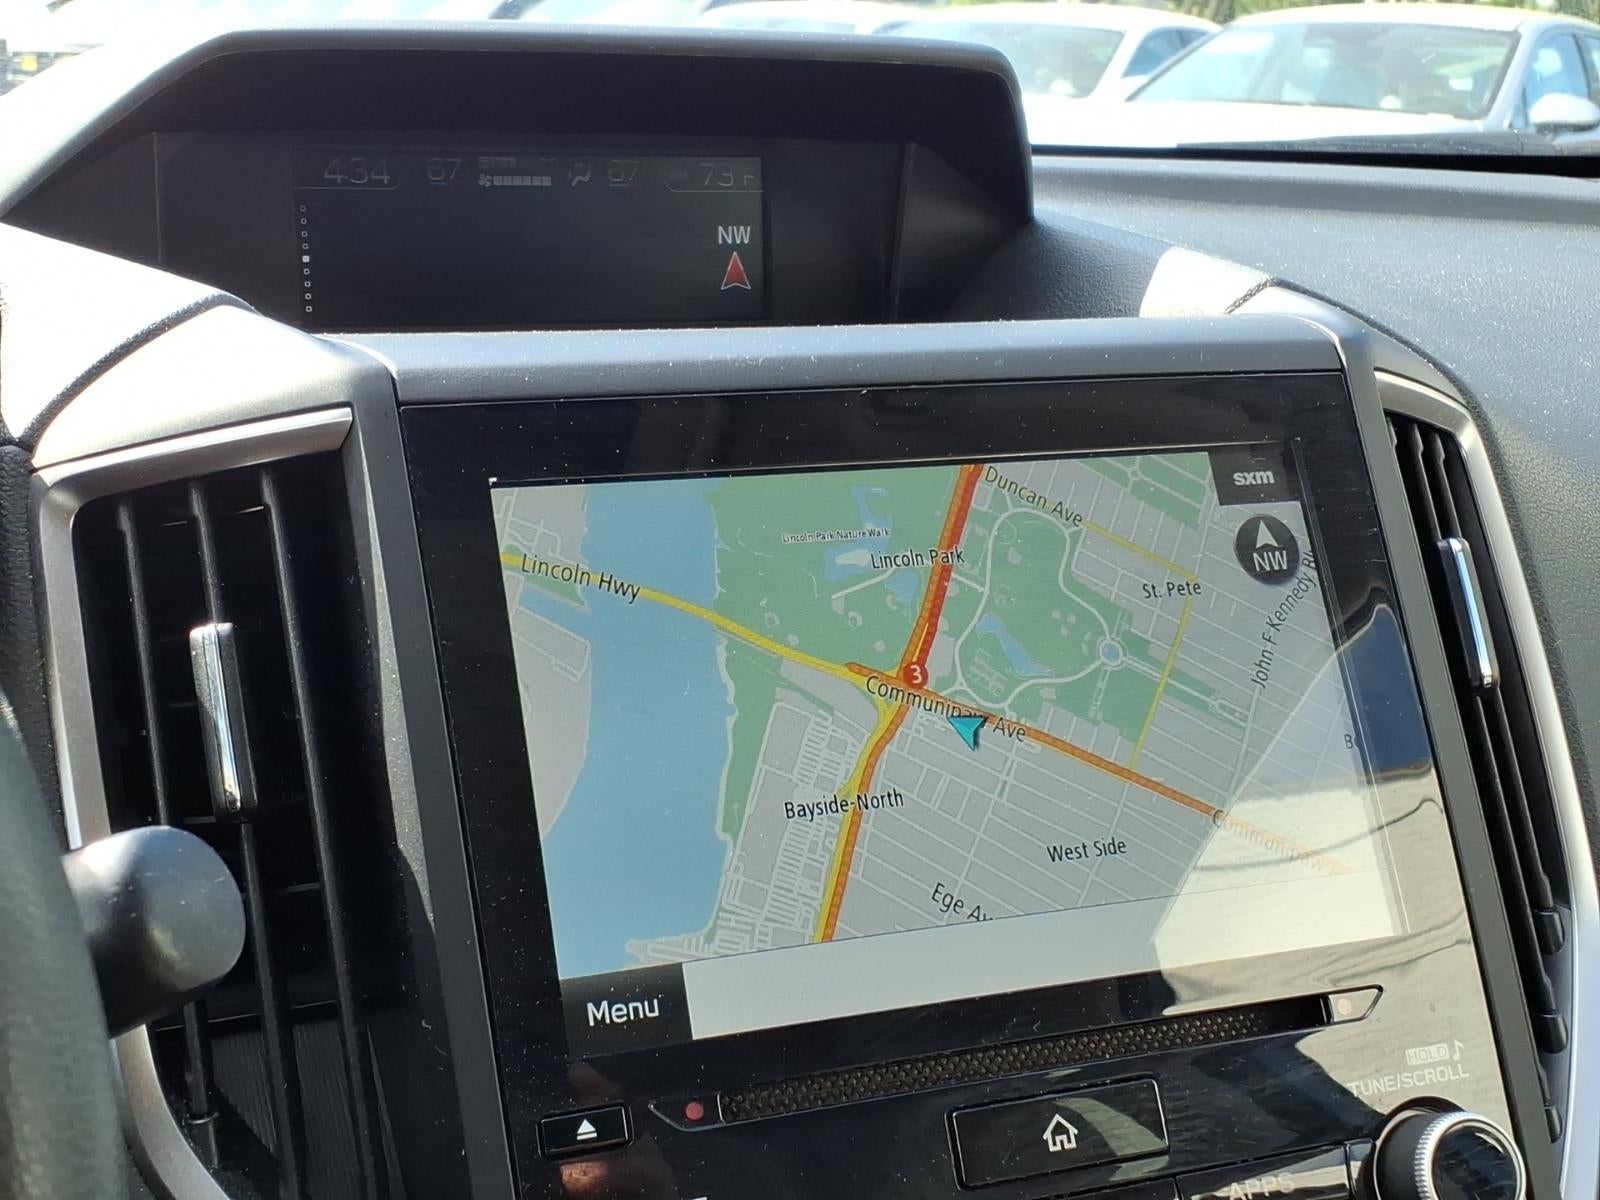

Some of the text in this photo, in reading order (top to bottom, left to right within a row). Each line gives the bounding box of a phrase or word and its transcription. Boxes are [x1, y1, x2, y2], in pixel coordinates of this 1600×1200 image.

[699, 161, 734, 186] 73
[717, 225, 751, 244] NW
[1233, 469, 1275, 486] sxm
[984, 465, 1083, 527] Duncan Ave
[782, 528, 889, 543] Lincoln Park Nature Walk
[871, 546, 965, 569] Lincoln Park
[1252, 550, 1288, 572] NW
[521, 553, 641, 604] Lincoln Hwy
[1142, 578, 1202, 599] St. Pete
[1251, 649, 1274, 689] John
[1273, 577, 1317, 634] Kennedy
[909, 665, 922, 683] 3
[993, 716, 1027, 742] Ave
[784, 788, 904, 822] Bayside-North
[1047, 837, 1127, 863] West Side
[931, 881, 964, 915] Ege
[586, 996, 660, 1027] Menu
[1406, 1044, 1448, 1064] HOLD
[1346, 1064, 1470, 1097] TUNE/SCROLL
[1229, 1172, 1296, 1200] APPS
